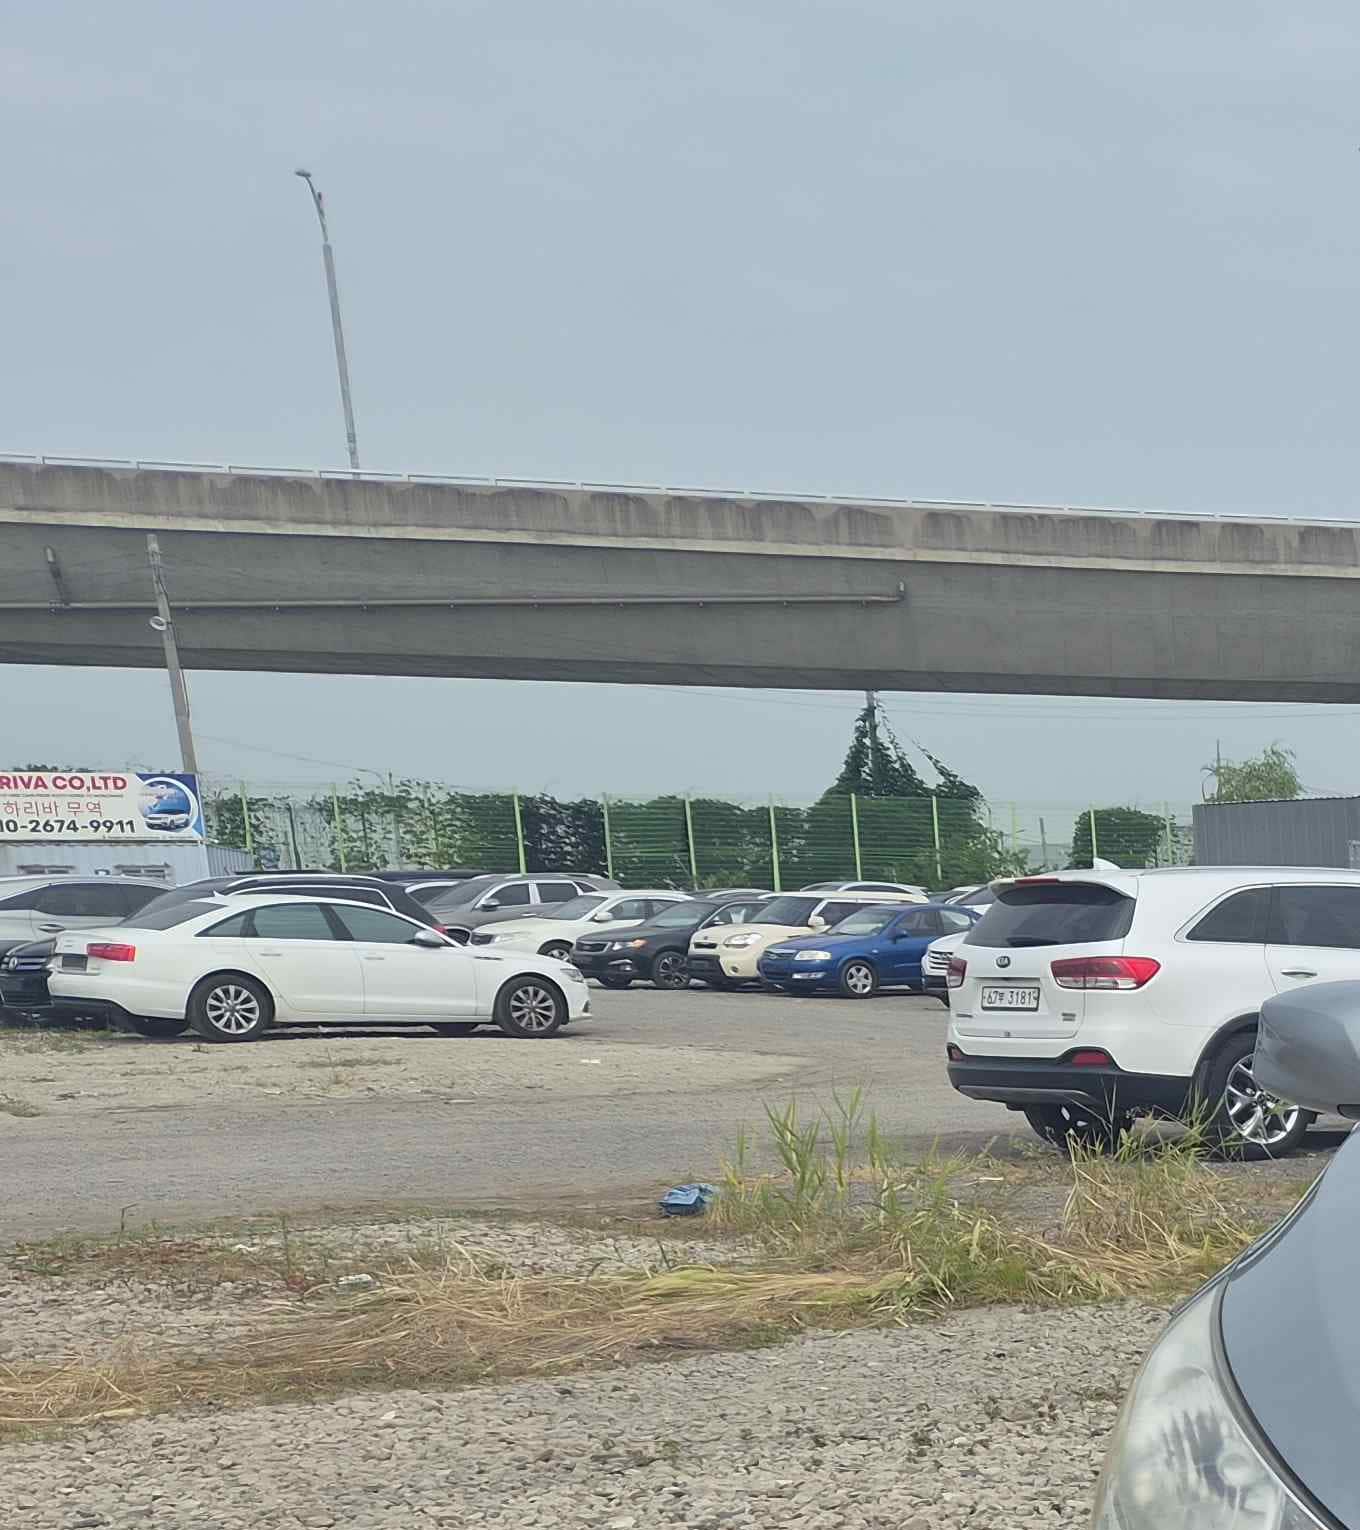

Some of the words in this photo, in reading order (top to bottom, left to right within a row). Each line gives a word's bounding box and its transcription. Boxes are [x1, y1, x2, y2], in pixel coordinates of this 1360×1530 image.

[52, 775, 128, 792] CO,LTD
[3, 800, 59, 817] 하리바
[67, 800, 103, 817] 무역
